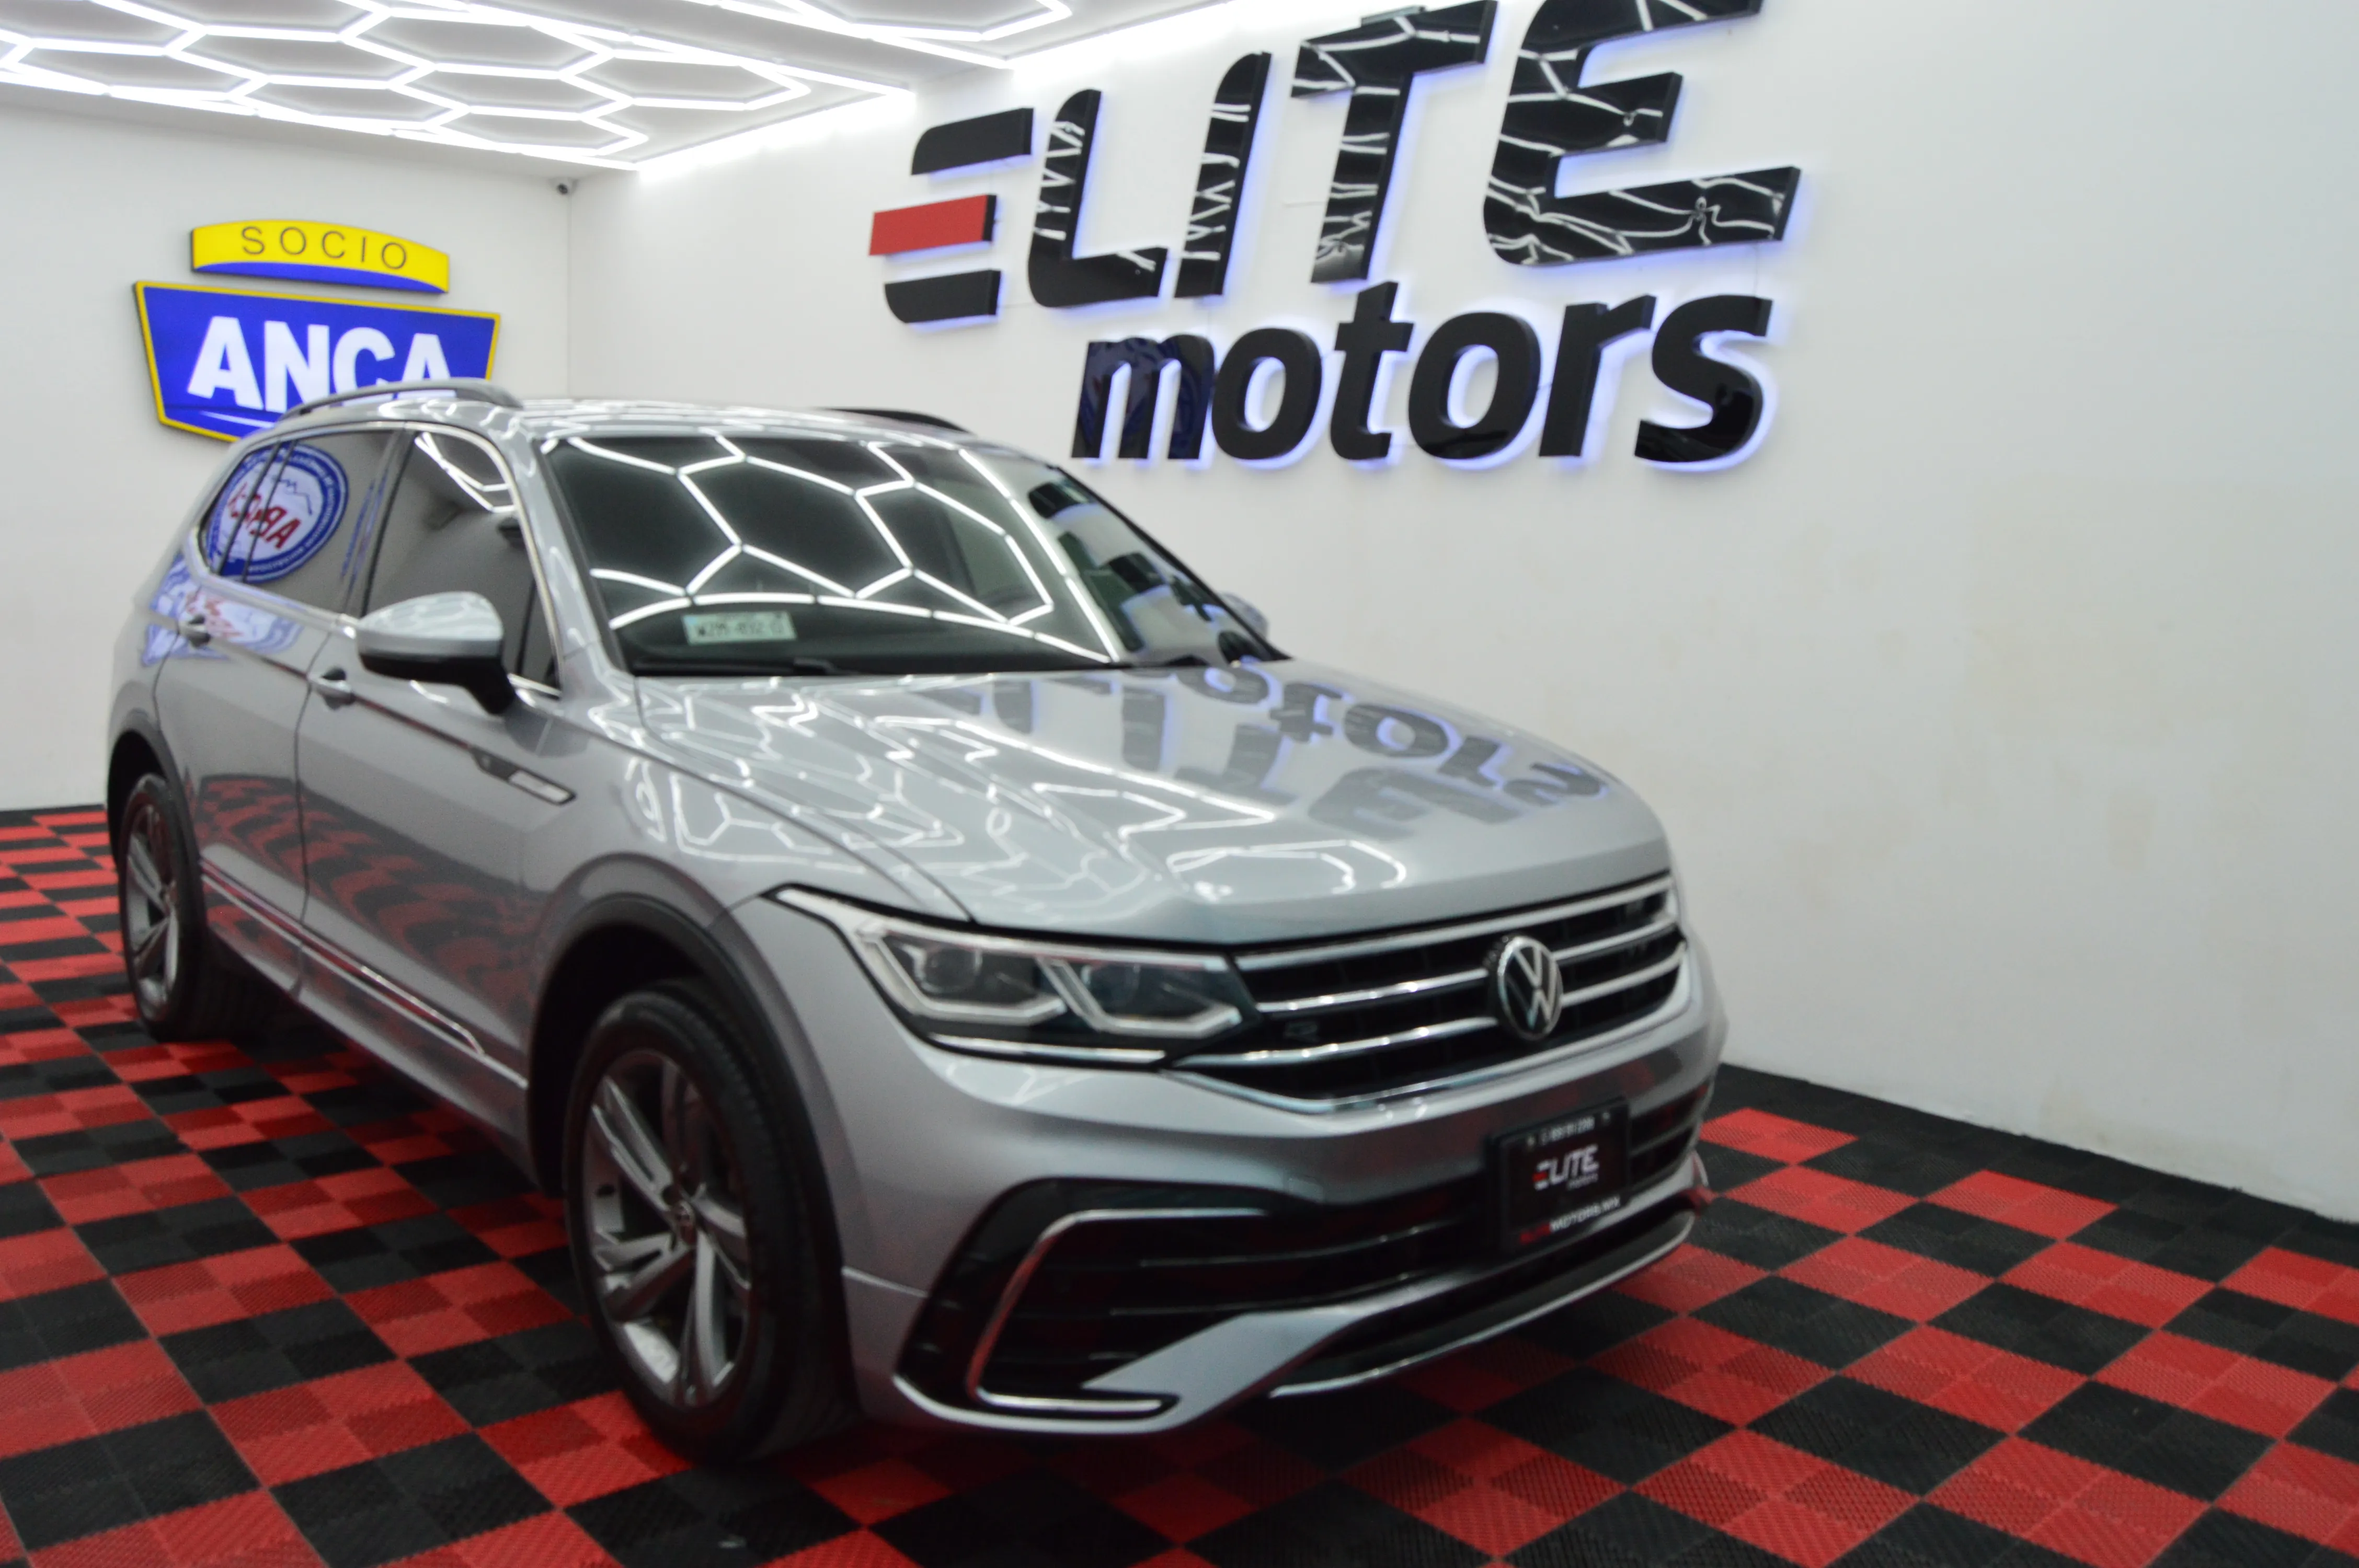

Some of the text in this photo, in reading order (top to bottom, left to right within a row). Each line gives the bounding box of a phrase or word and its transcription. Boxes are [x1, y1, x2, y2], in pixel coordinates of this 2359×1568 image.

[868, 0, 1801, 323] ELITE
[241, 226, 407, 270] SOCIO
[187, 316, 457, 412] ANCA
[1071, 282, 1773, 463] motors
[1532, 1144, 1599, 1191] ELITE
